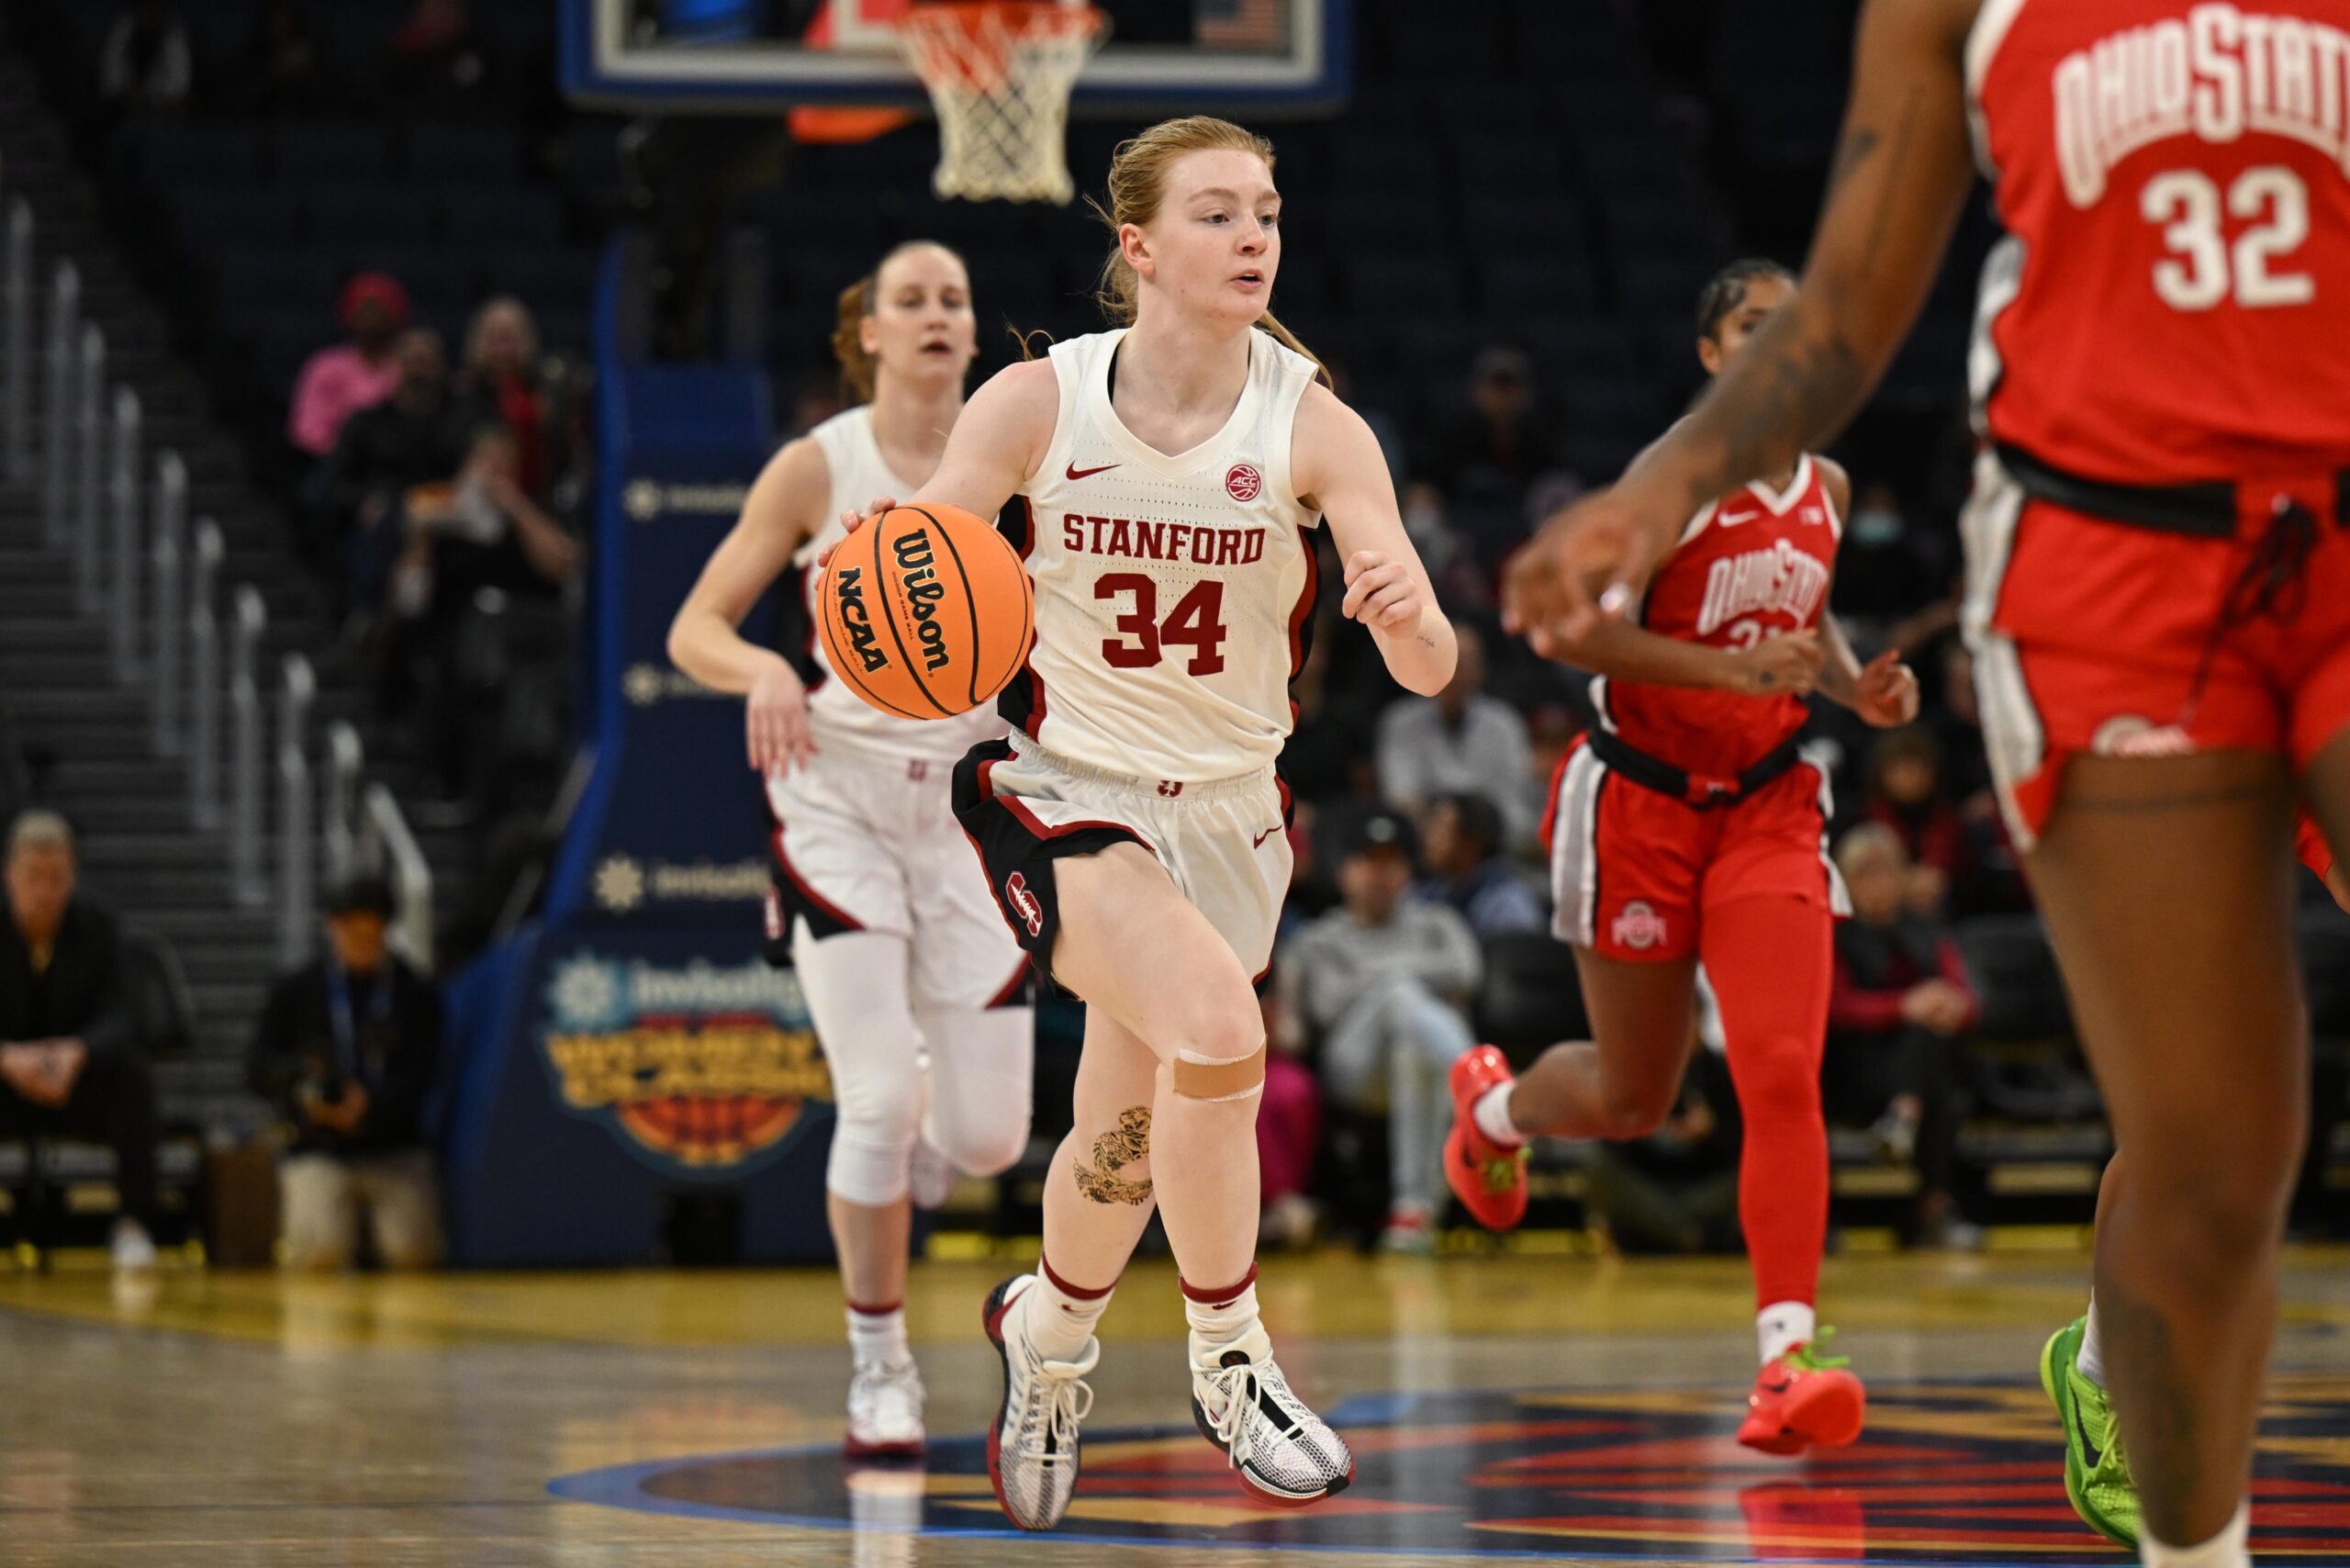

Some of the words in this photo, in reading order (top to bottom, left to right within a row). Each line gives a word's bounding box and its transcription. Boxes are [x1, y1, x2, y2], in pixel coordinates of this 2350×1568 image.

[2140, 164, 2316, 312] 32
[1230, 476, 1259, 486] ACC
[1063, 512, 1266, 566] STANFORD
[837, 566, 890, 674] NCAA
[892, 527, 951, 674] Wilson
[1093, 573, 1226, 677] 34
